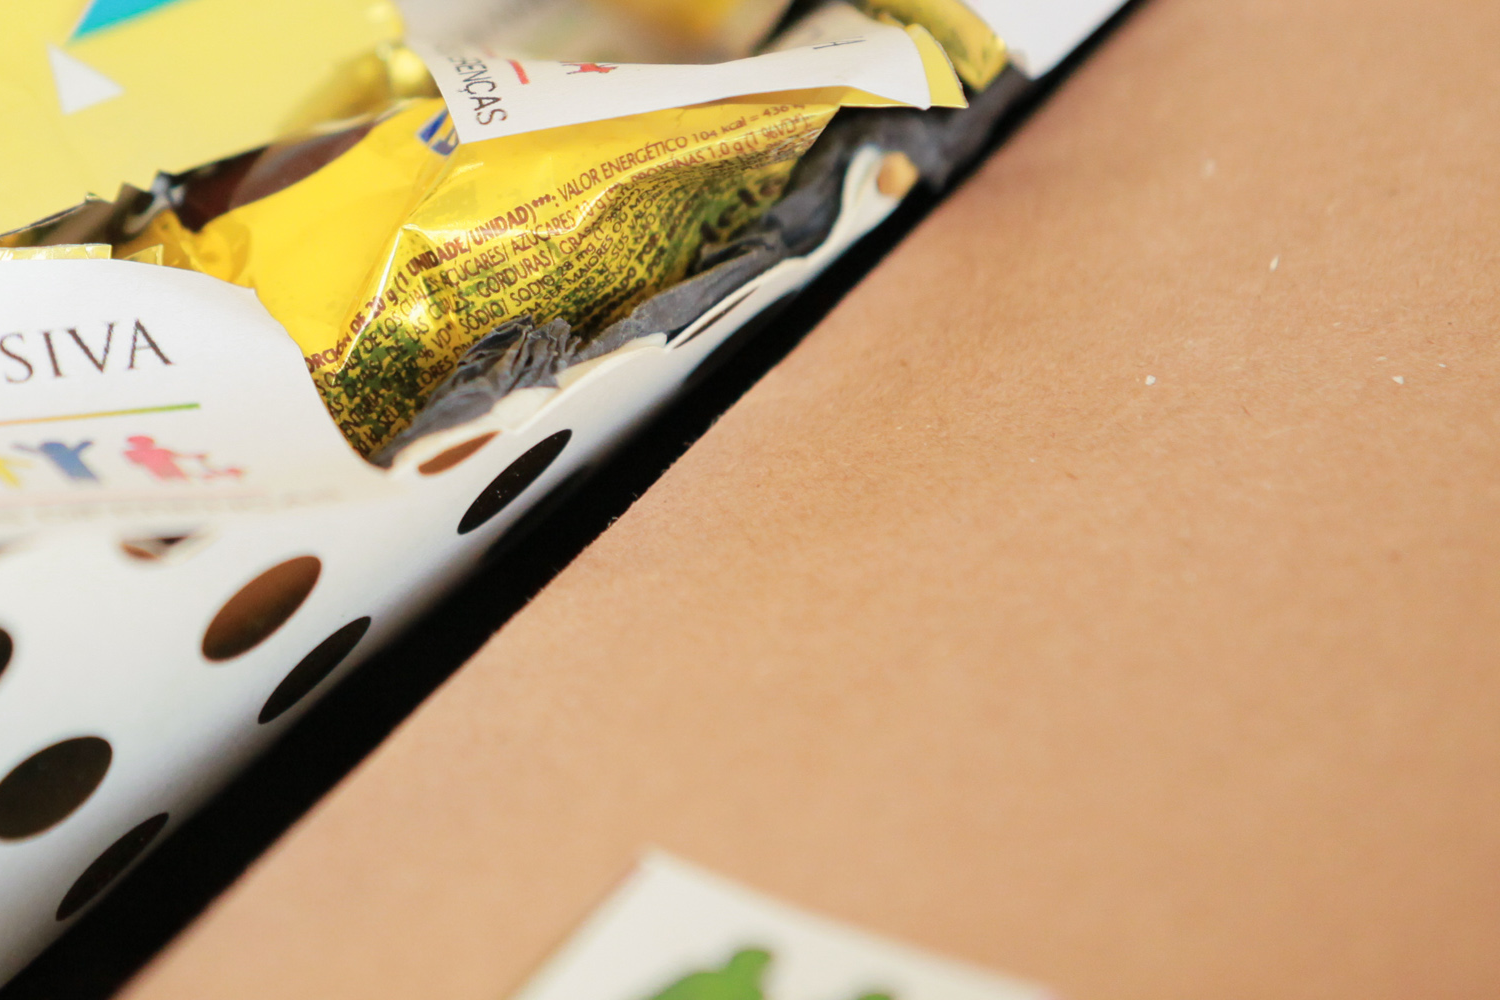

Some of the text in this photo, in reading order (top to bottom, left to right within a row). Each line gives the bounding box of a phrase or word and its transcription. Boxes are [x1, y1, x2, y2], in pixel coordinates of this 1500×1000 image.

[556, 167, 601, 201] VALOR
[599, 134, 688, 179] ENERGÉTICO
[720, 116, 746, 133] kcal
[474, 247, 555, 299] GORDURAS/
[566, 235, 615, 285] MAIORES
[611, 213, 628, 233] OU
[510, 272, 555, 306] SODIO
[360, 332, 382, 353] DE
[378, 311, 402, 338] LOS
